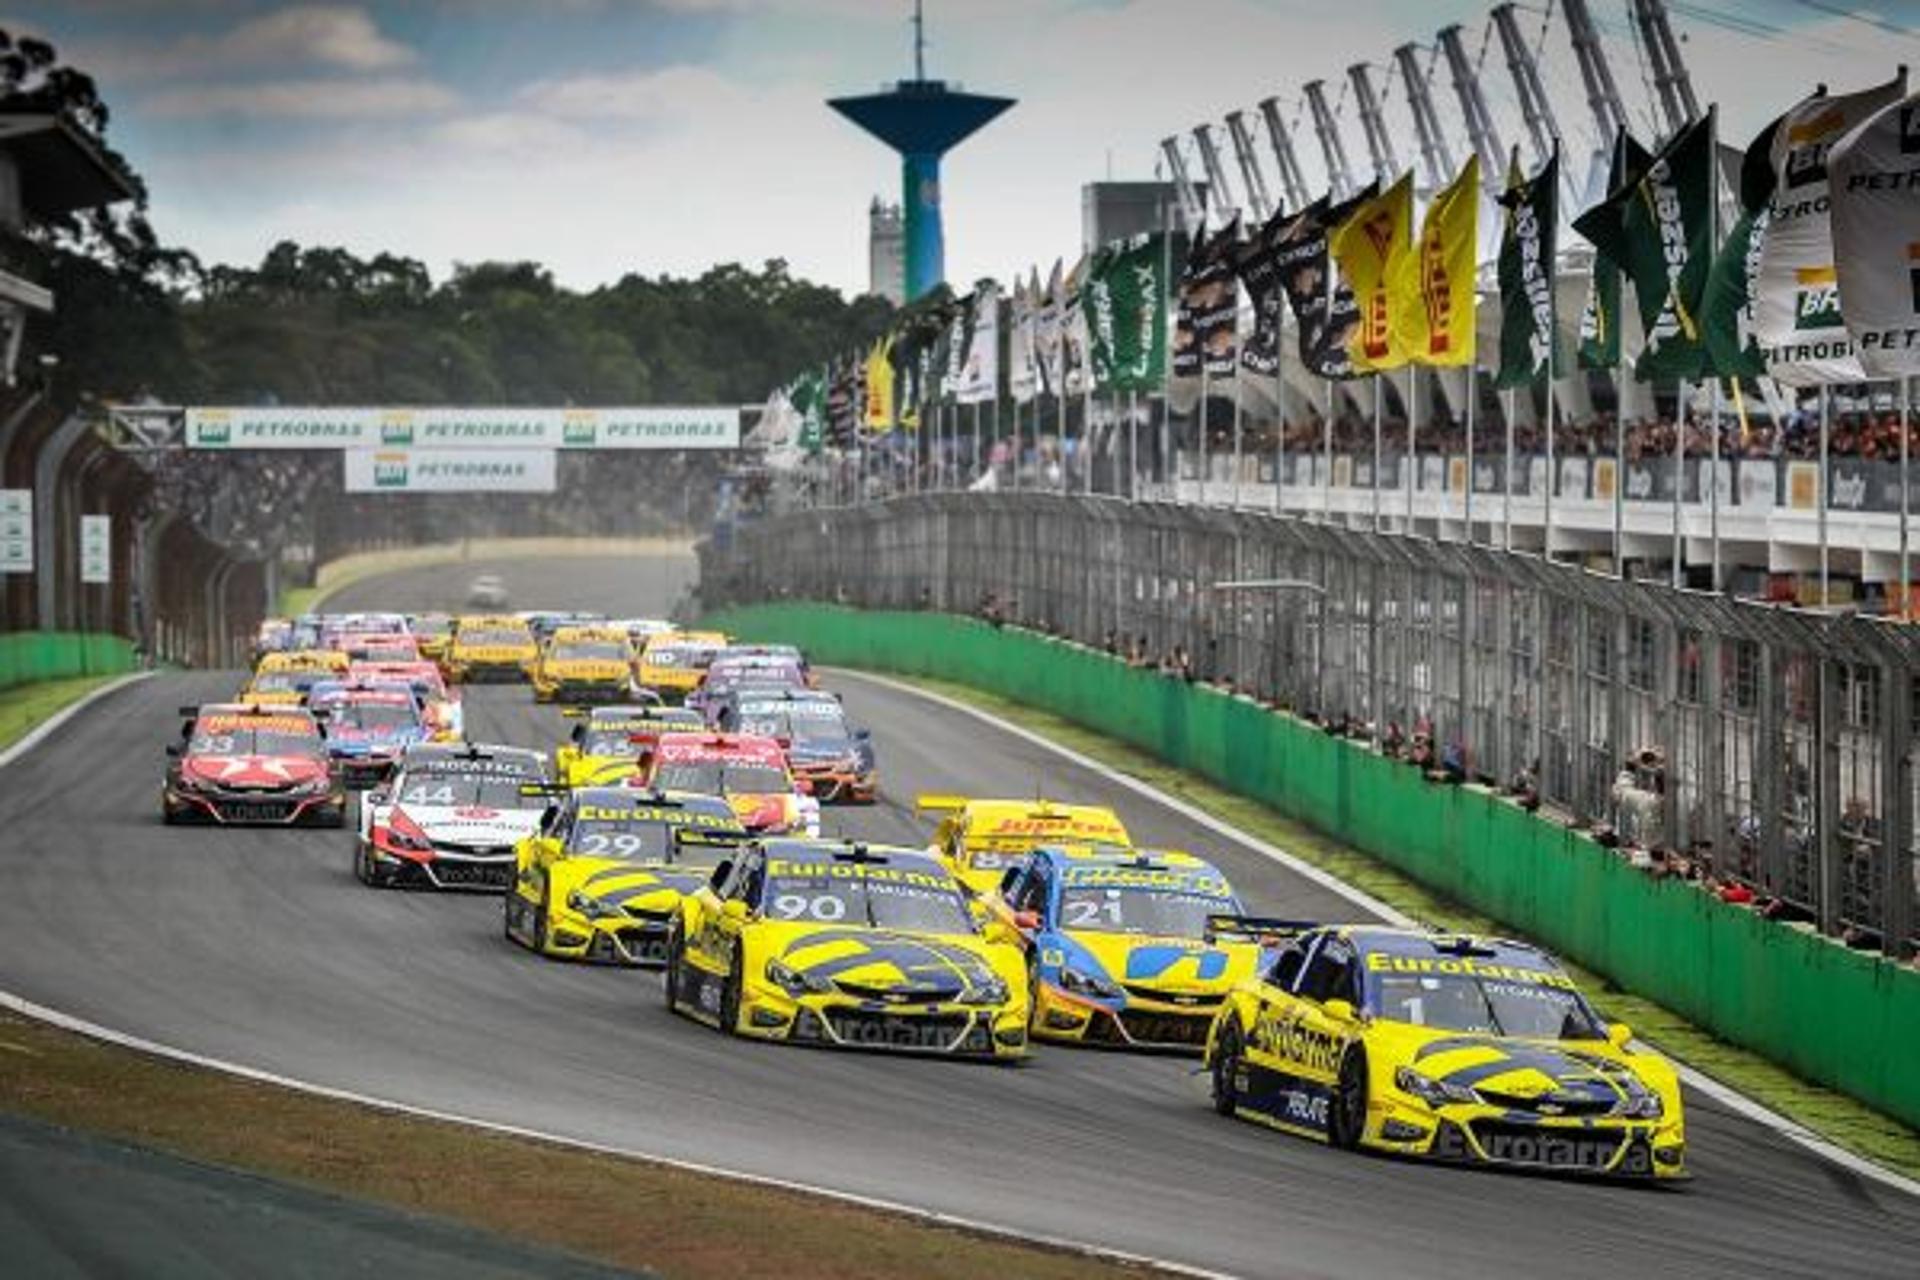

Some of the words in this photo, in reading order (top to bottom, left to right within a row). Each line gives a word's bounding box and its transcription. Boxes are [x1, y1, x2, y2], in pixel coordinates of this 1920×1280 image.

[405, 785, 455, 803] 44
[581, 833, 642, 856] 29
[767, 860, 958, 891] Eurofarma
[773, 894, 845, 920] 90
[1063, 902, 1123, 927] 21
[1366, 951, 1575, 990] Eurofarma
